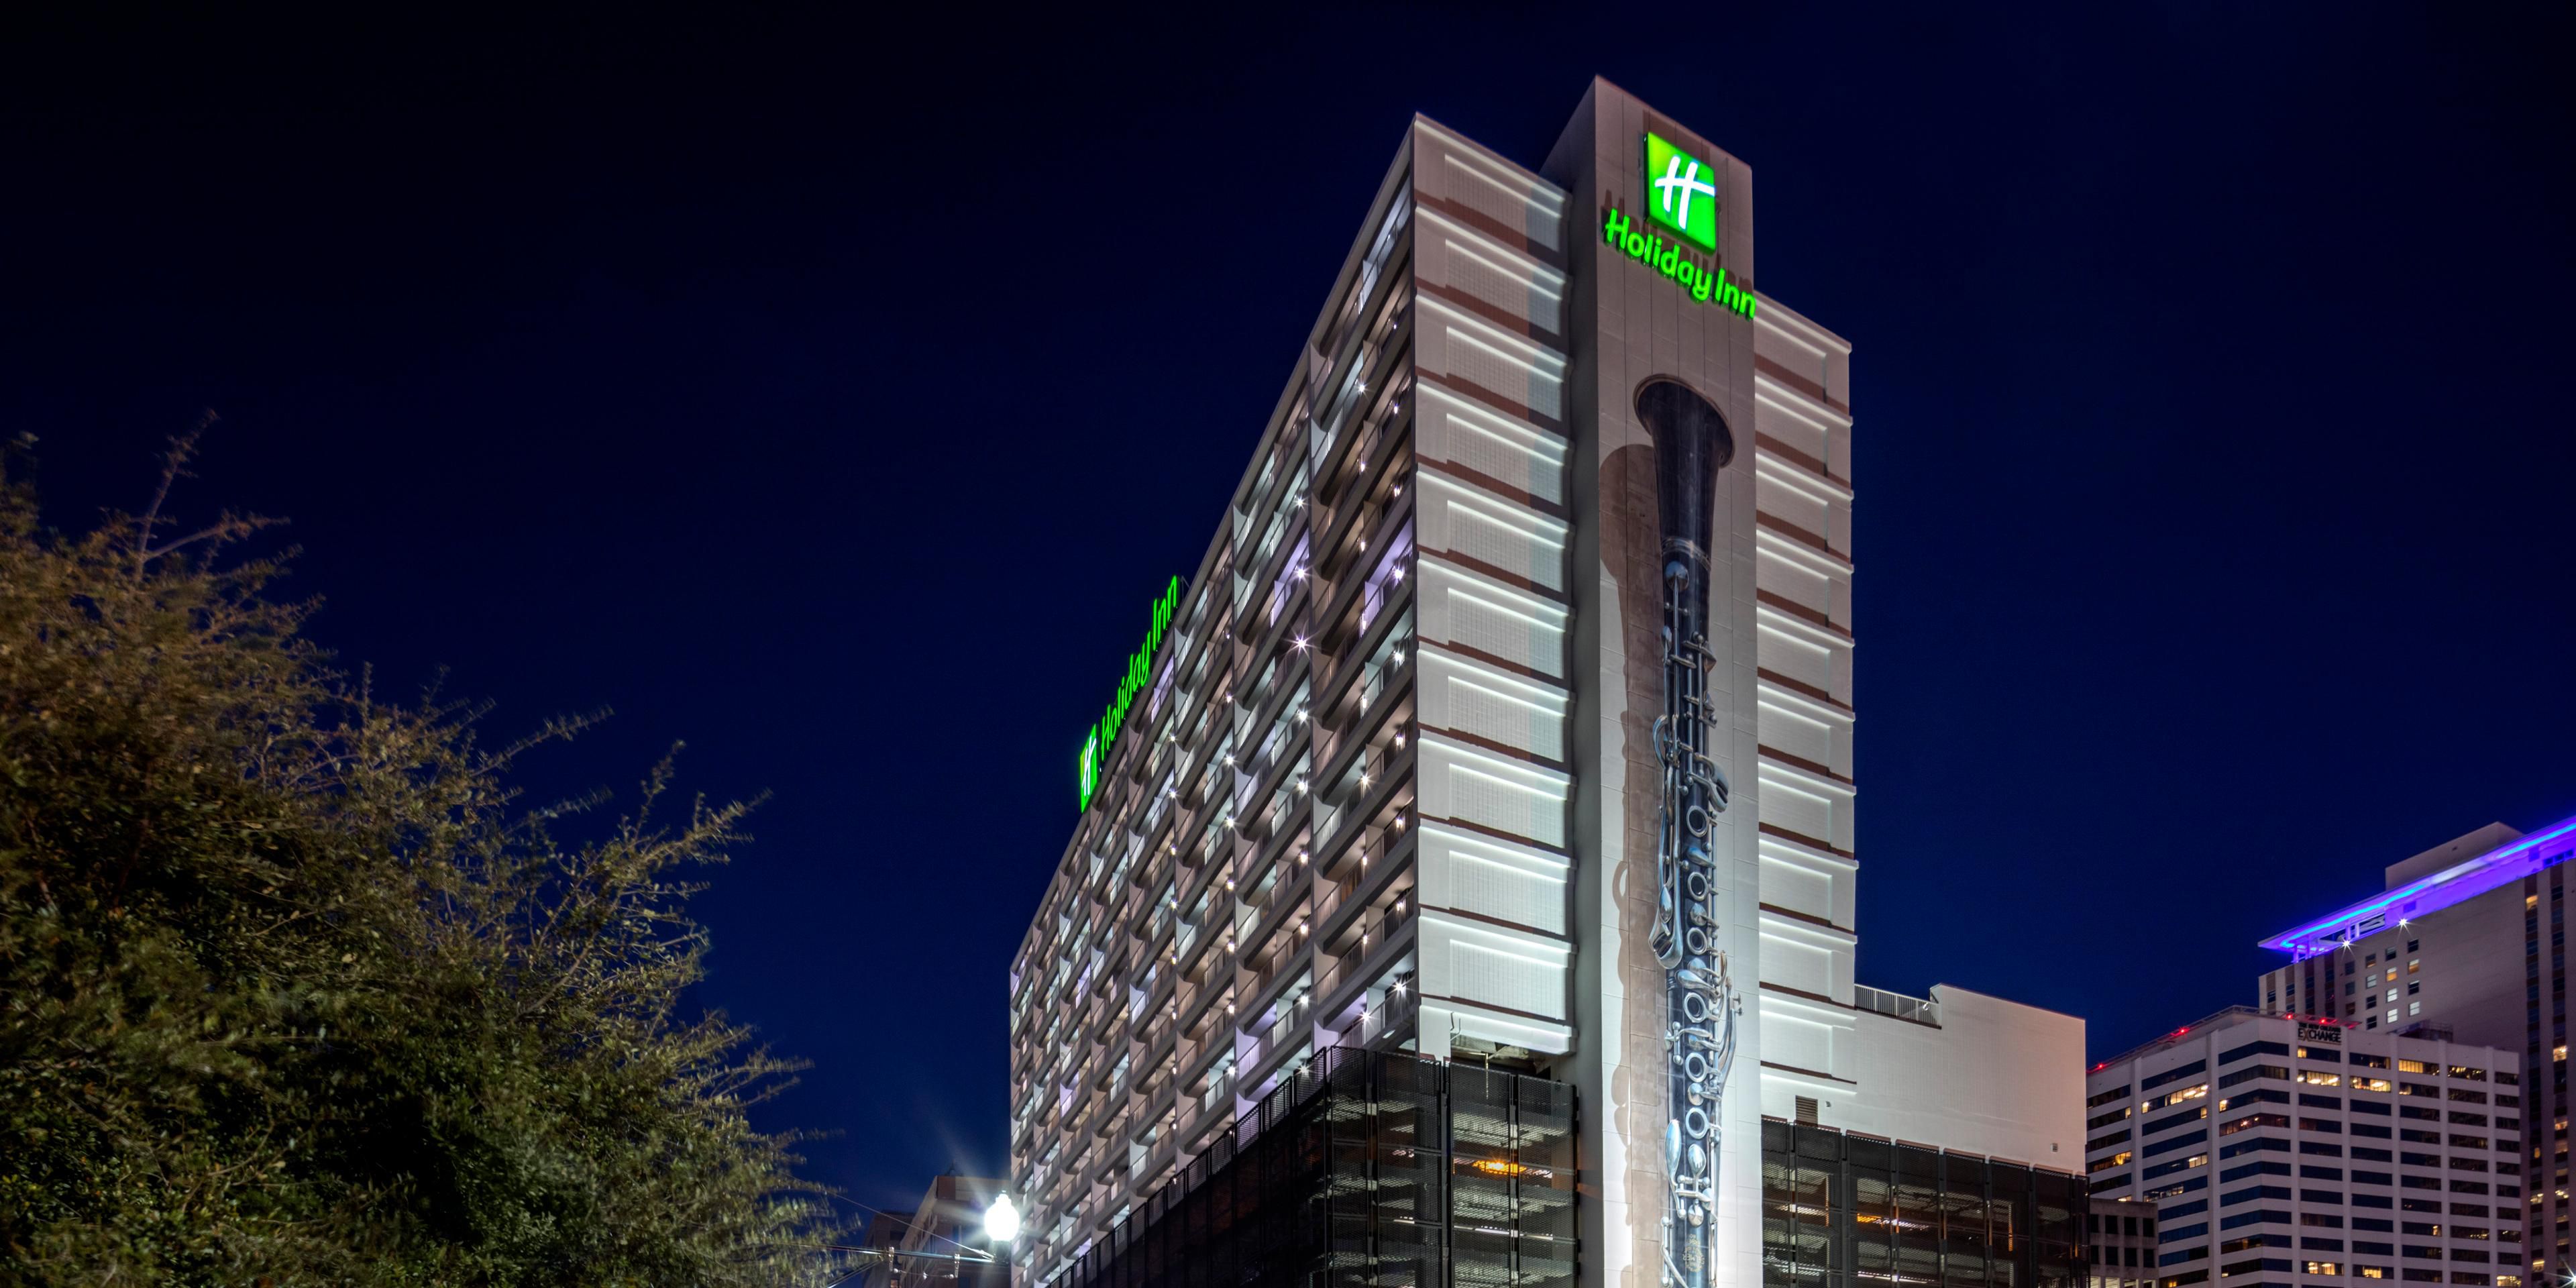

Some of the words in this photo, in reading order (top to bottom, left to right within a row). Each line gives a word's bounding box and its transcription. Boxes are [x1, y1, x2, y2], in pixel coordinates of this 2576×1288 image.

[1605, 208, 1713, 302] Holiday
[1715, 268, 1757, 319] Inn
[1100, 631, 1151, 761] Holiday
[1152, 575, 1177, 651] Inn
[2298, 1028, 2341, 1042] EXCHANGE
